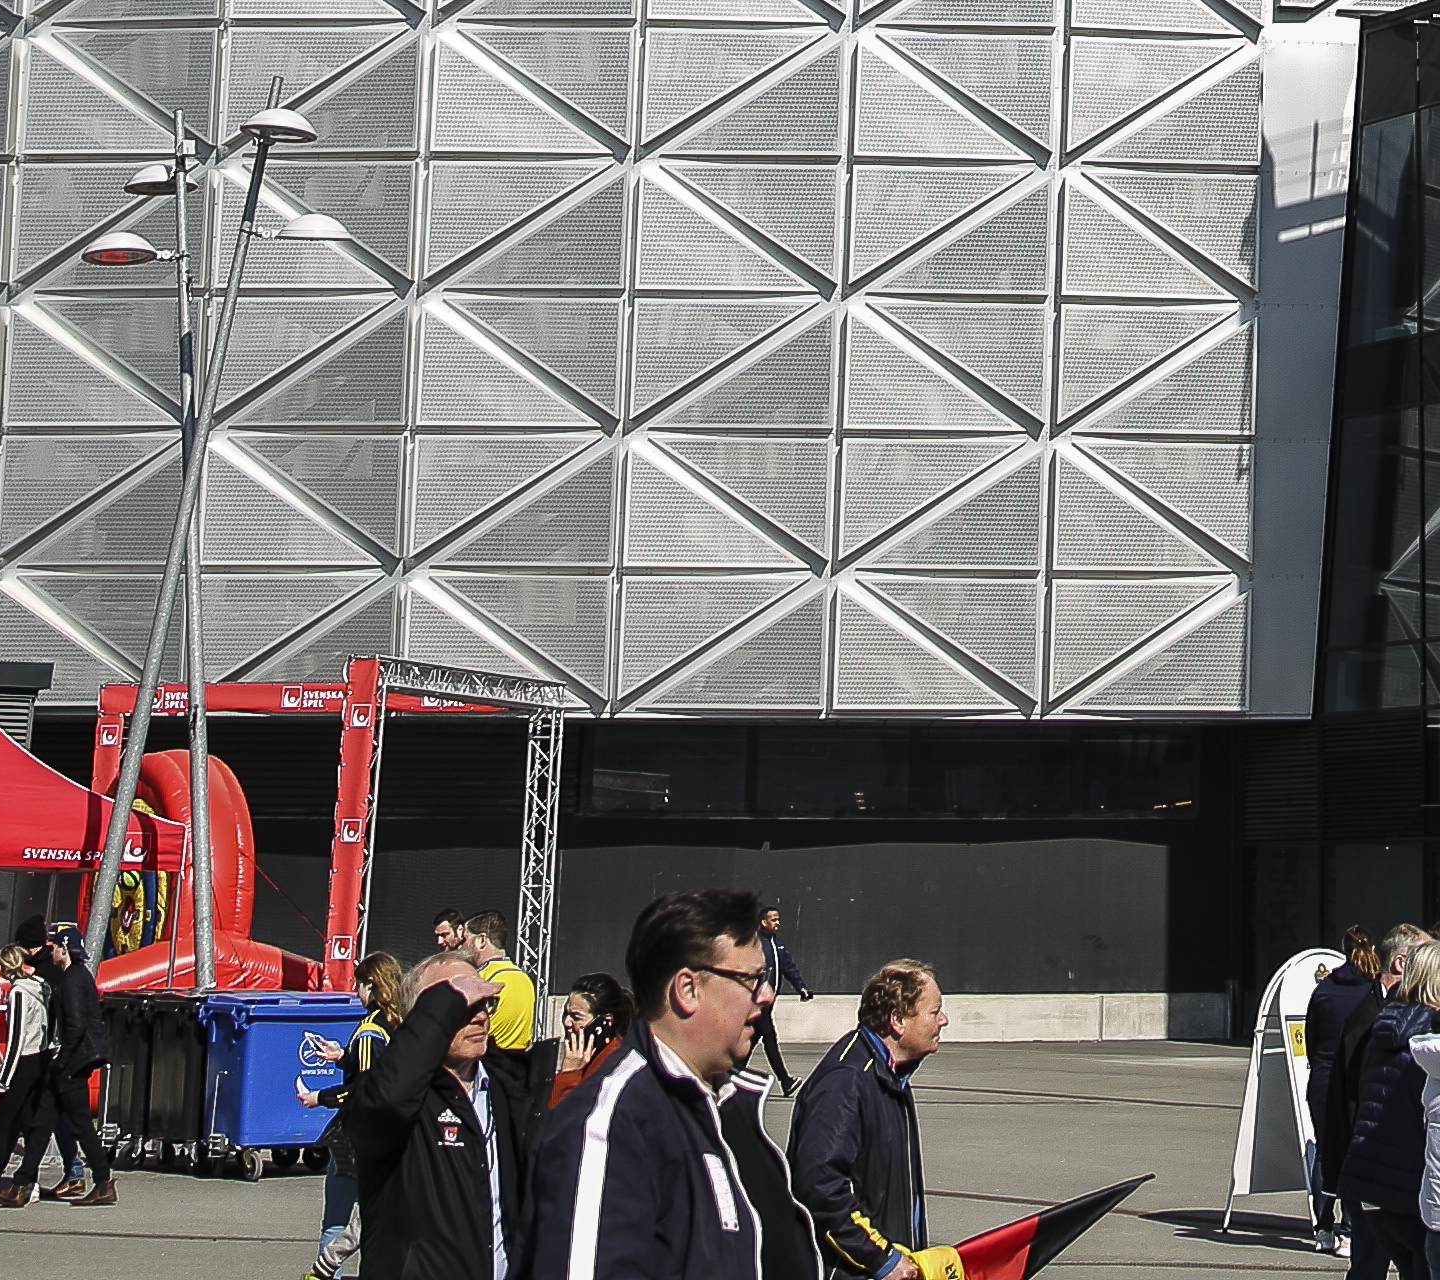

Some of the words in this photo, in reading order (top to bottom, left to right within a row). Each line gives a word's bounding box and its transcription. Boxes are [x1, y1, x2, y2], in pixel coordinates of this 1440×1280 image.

[164, 691, 189, 701] SVEN
[303, 689, 344, 700] SVENSKA
[164, 700, 187, 709] SPEL
[302, 699, 324, 709] SPEL
[22, 847, 82, 861] SVENSKA
